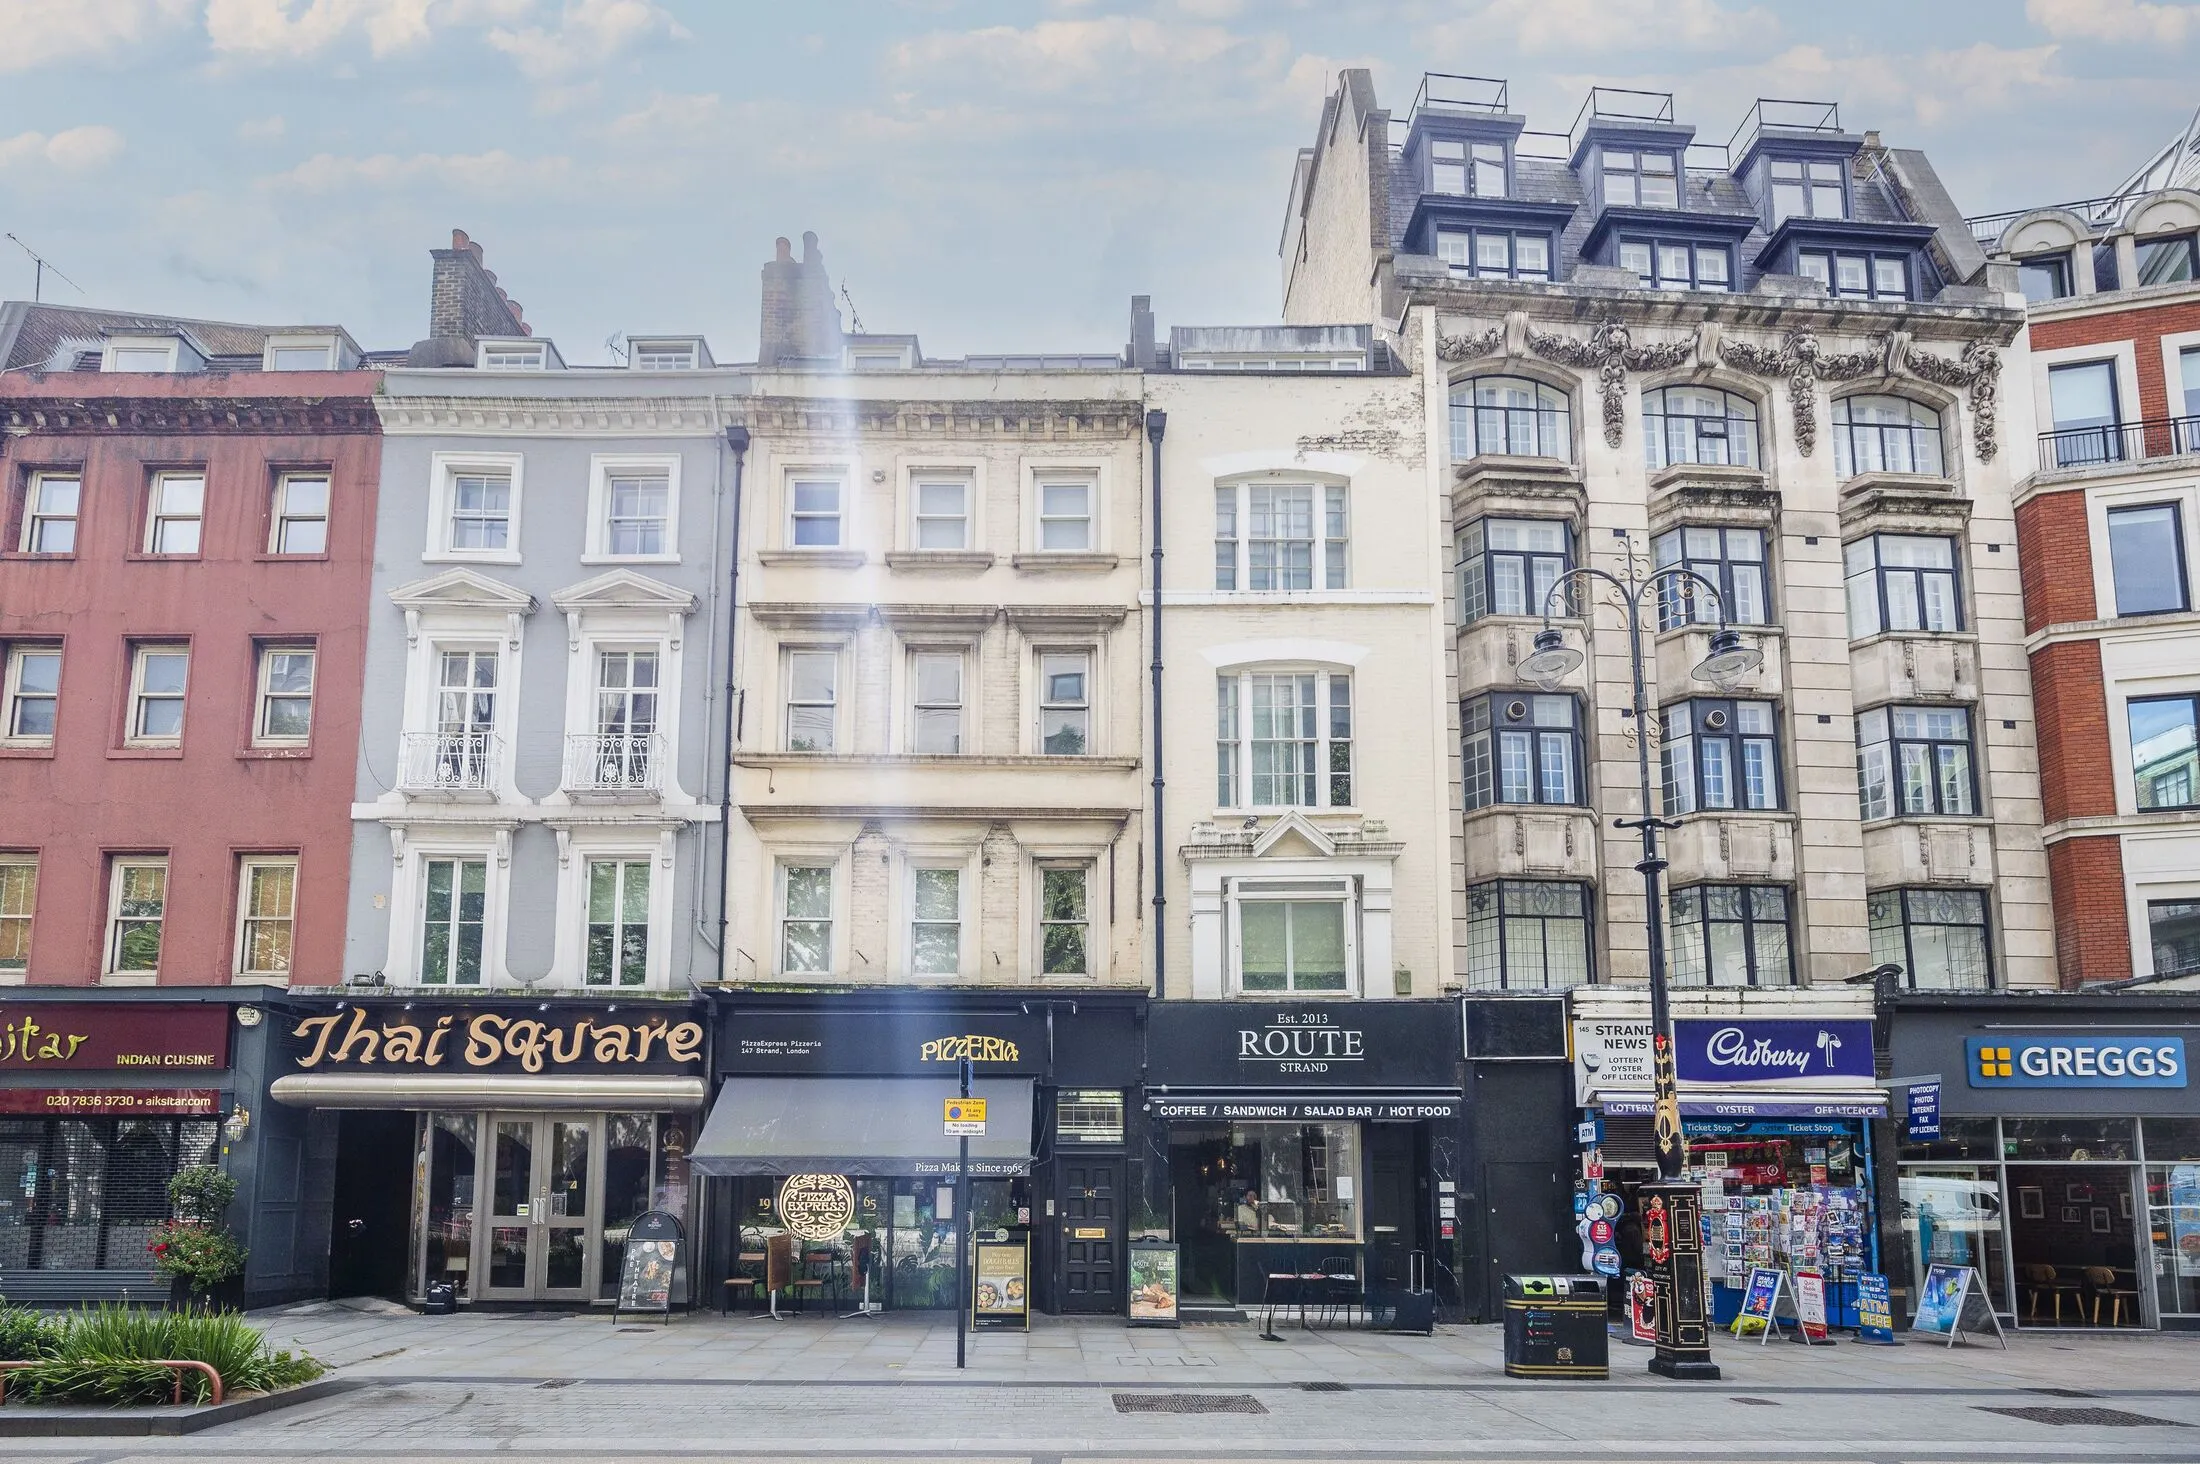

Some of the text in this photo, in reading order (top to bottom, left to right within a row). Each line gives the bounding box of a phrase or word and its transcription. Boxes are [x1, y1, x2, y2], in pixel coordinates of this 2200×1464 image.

[1277, 1013, 1328, 1023] Est. 2013
[1595, 1025, 1654, 1036] STRAND
[0, 1016, 89, 1062] itar
[291, 1005, 703, 1073] Thai Square
[741, 1040, 788, 1048] PizzaExpress
[1238, 1030, 1365, 1056] ROUTE
[1604, 1038, 1648, 1050] NEWS
[755, 1047, 783, 1055] Strand,
[920, 1034, 1020, 1062] PIZZERIA
[1706, 1027, 1810, 1073] Cadbury
[116, 1054, 215, 1065] INDIAN CUISINE
[2019, 1046, 2178, 1078] GREGGS
[1280, 1062, 1328, 1073] STRAND
[1601, 1073, 1617, 1081] OFF
[1909, 1085, 1939, 1094] PHOTOCOPY
[46, 1095, 211, 1107] 020 7836 3730 aiksitar.com
[1914, 1096, 1934, 1104] PHOTOS
[1160, 1106, 1207, 1116] COFFEE
[1223, 1106, 1287, 1116] SANDWICH
[1304, 1106, 1345, 1116] SALAD
[1347, 1106, 1373, 1116] BAR
[1389, 1106, 1415, 1117] HOT
[1417, 1106, 1451, 1116] FOOD
[1610, 1103, 1879, 1115] LOTTERY OYSTER OFF LICENCE
[1912, 1105, 1935, 1114] INTERNET
[1581, 1127, 1594, 1137] ATM
[1686, 1123, 1733, 1133] Ticket Stop
[1787, 1123, 1813, 1132] Ticket
[1814, 1123, 1833, 1133] Stop
[1909, 1125, 1939, 1134] OFF LICENCE
[915, 1162, 1023, 1175] Pizza Maks Since 1965
[797, 1191, 836, 1202] PIZZA
[1084, 1189, 1097, 1197] 147
[758, 1195, 877, 1210] 19 65
[787, 1201, 847, 1212] EXPRESS
[629, 1248, 637, 1268] PRE
[631, 1260, 641, 1307] THEATRE
[1860, 1298, 1890, 1314] ATM
[1860, 1311, 1892, 1328] HERE
